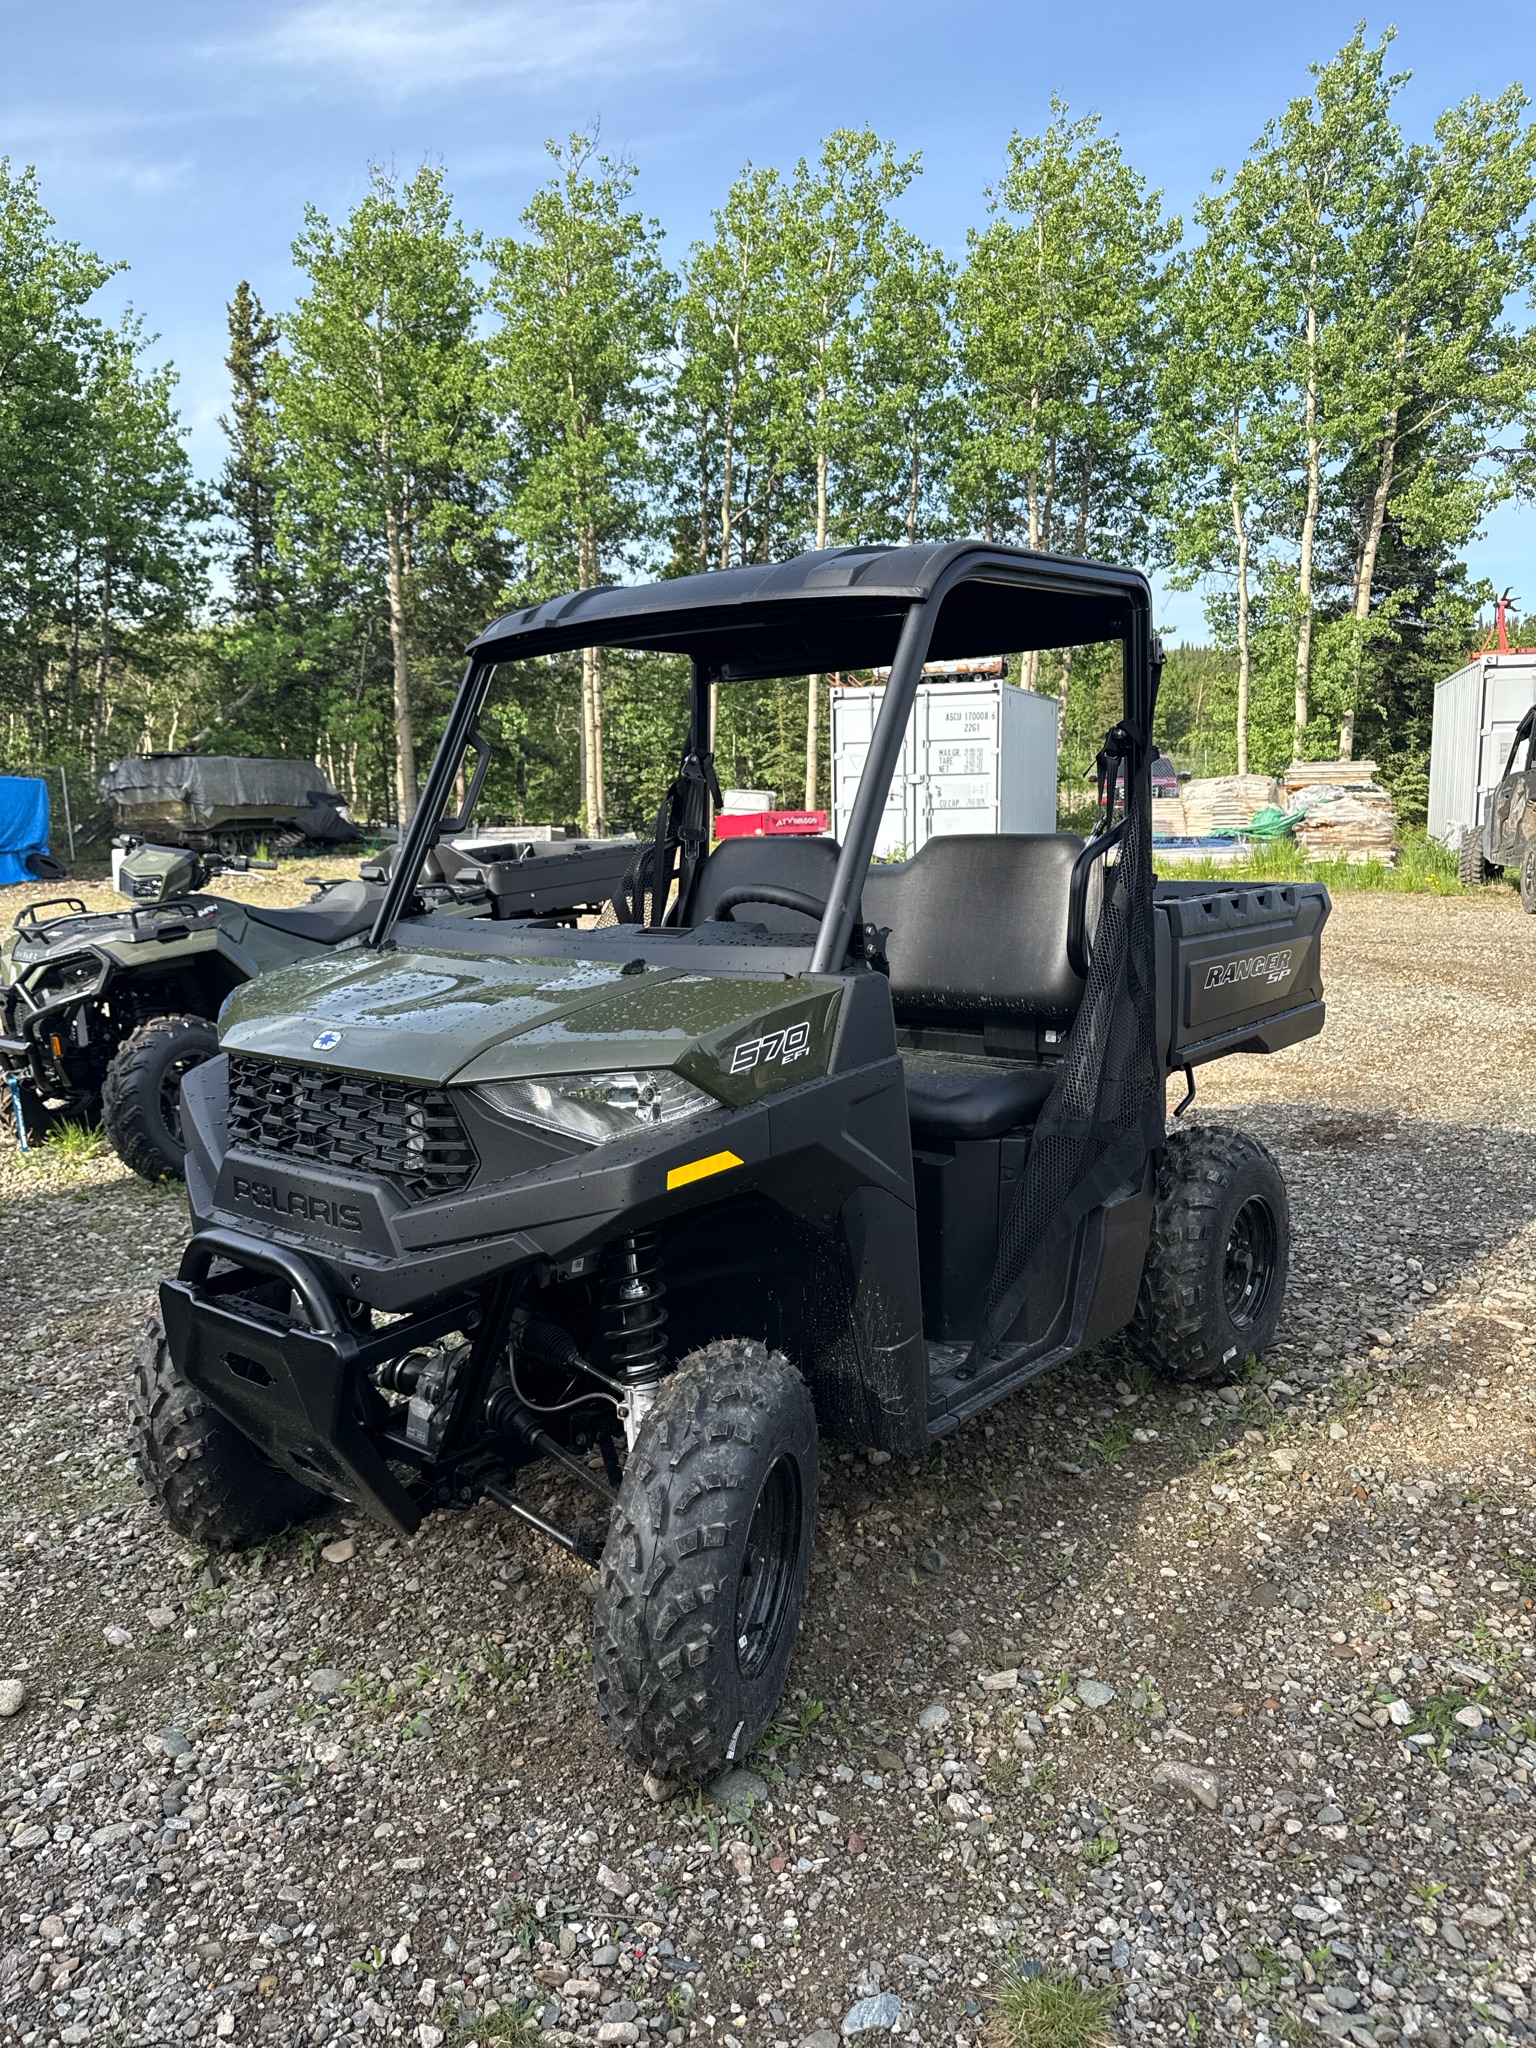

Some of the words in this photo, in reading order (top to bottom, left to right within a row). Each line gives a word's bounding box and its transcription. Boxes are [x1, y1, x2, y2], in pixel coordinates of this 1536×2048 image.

[945, 712, 962, 721] ASCU
[965, 711, 989, 721] 170008
[964, 722, 980, 732] 22G1
[938, 765, 949, 774] NET
[939, 756, 954, 766] TARE
[1204, 949, 1292, 990] RANGER
[1266, 968, 1292, 985] SP
[729, 1021, 810, 1075] 570
[781, 1047, 810, 1066] EFI
[233, 1175, 363, 1234] POLARIS
